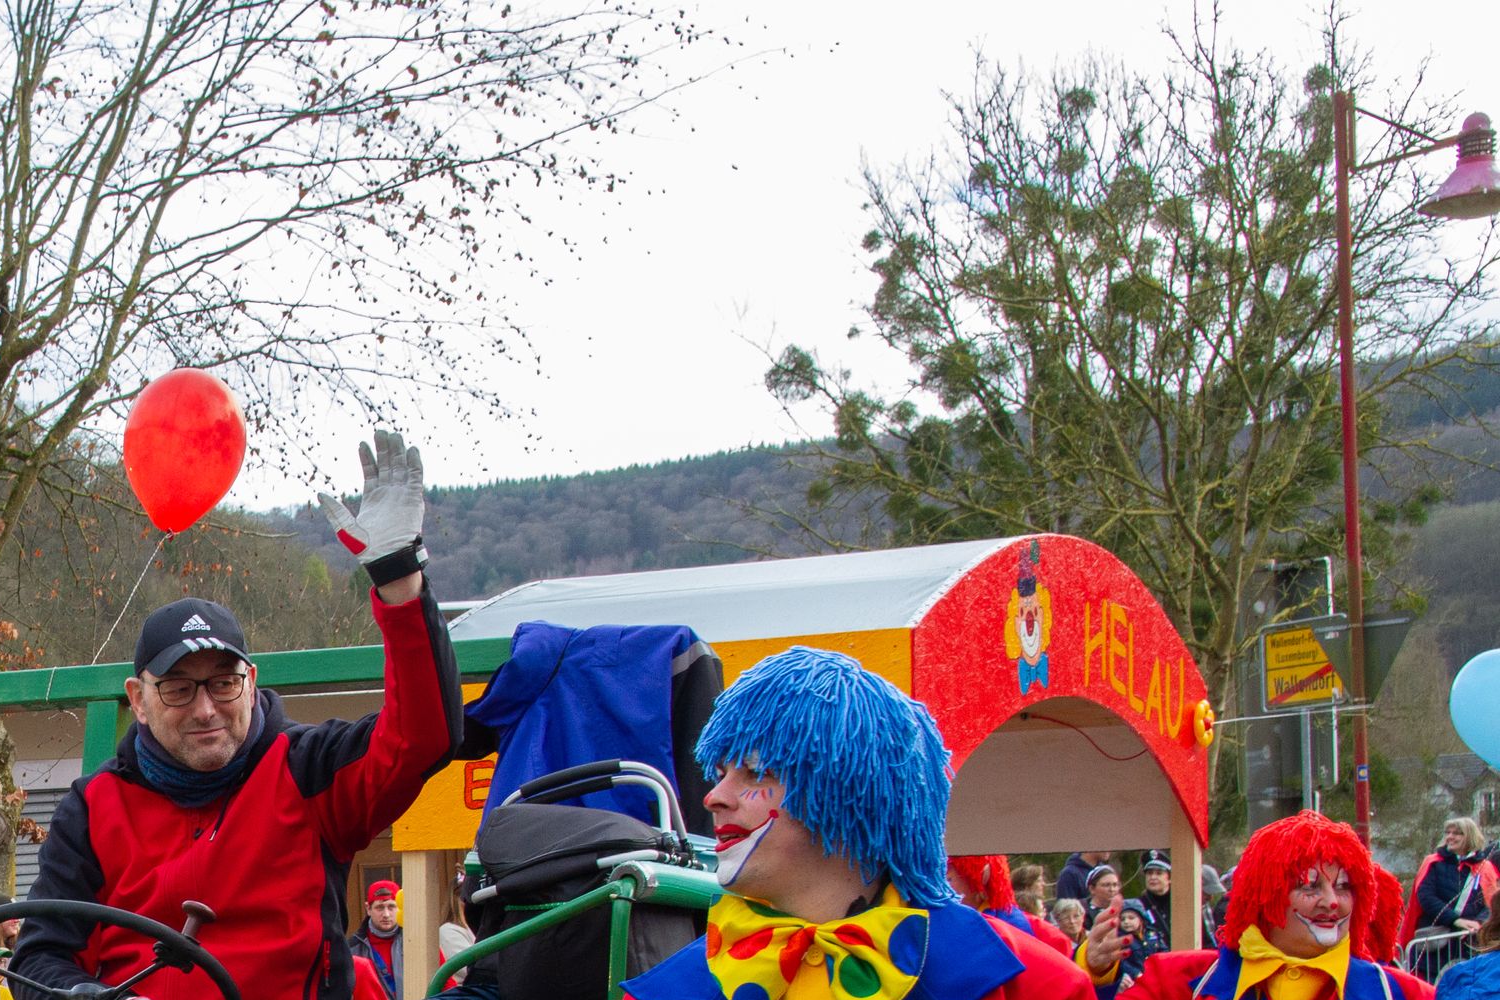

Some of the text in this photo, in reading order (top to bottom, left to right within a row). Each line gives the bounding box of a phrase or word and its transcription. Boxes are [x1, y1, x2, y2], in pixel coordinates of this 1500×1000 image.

[181, 623, 211, 632] adidas
[1084, 598, 1185, 740] HELAU
[1273, 672, 1335, 695] Wallendorf
